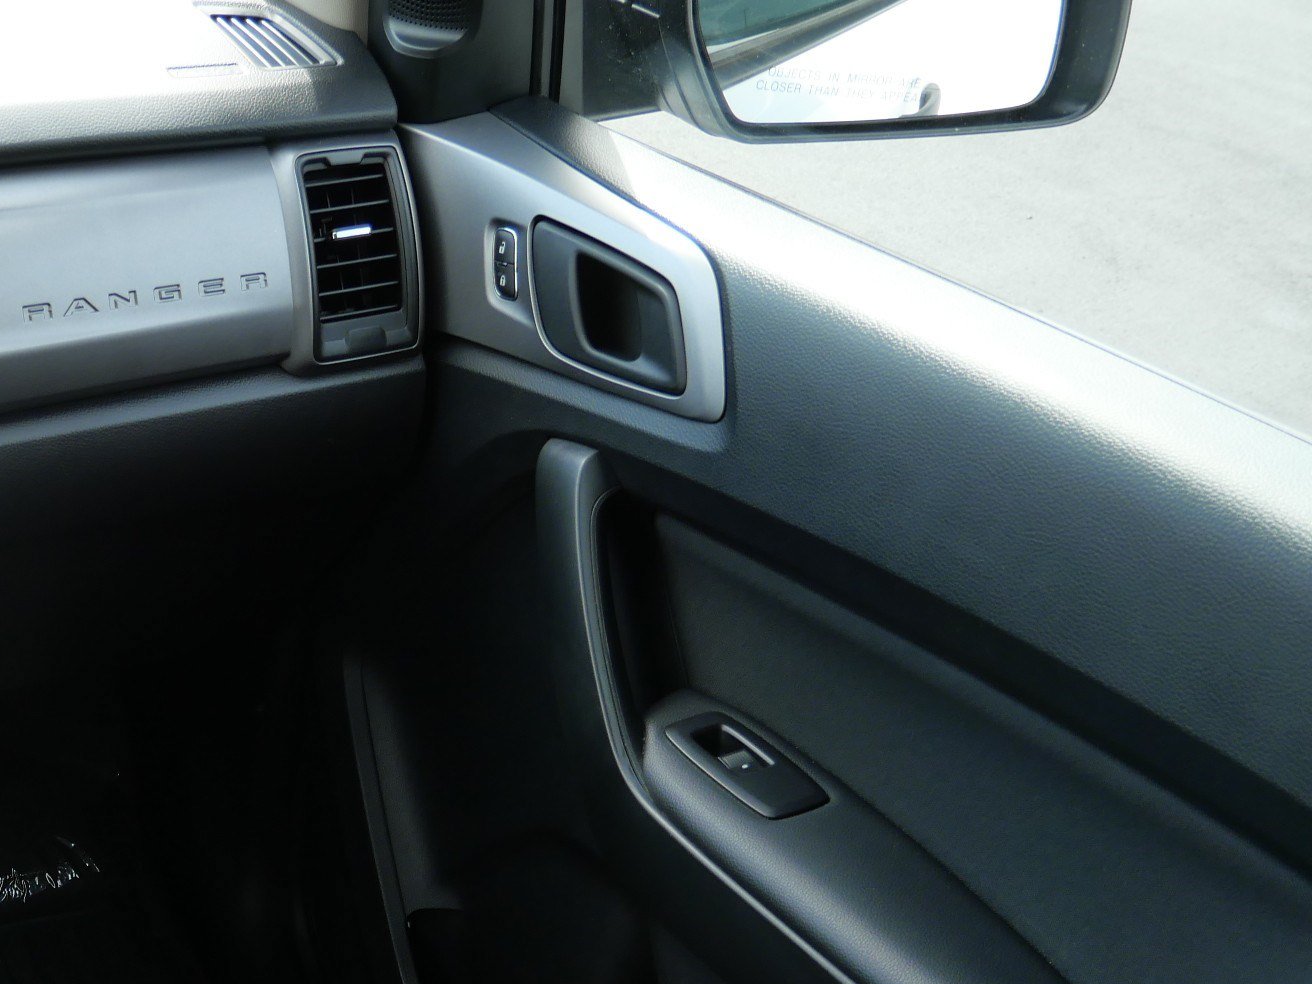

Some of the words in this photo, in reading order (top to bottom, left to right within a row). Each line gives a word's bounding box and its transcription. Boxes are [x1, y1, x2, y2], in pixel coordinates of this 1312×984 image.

[768, 66, 821, 82] OBJECTS
[828, 71, 839, 82] IN
[847, 73, 893, 86] MIRROR
[756, 79, 802, 94] CLOSER
[808, 84, 839, 97] THAN
[846, 87, 874, 99] THEY
[21, 271, 268, 323] RANGER
